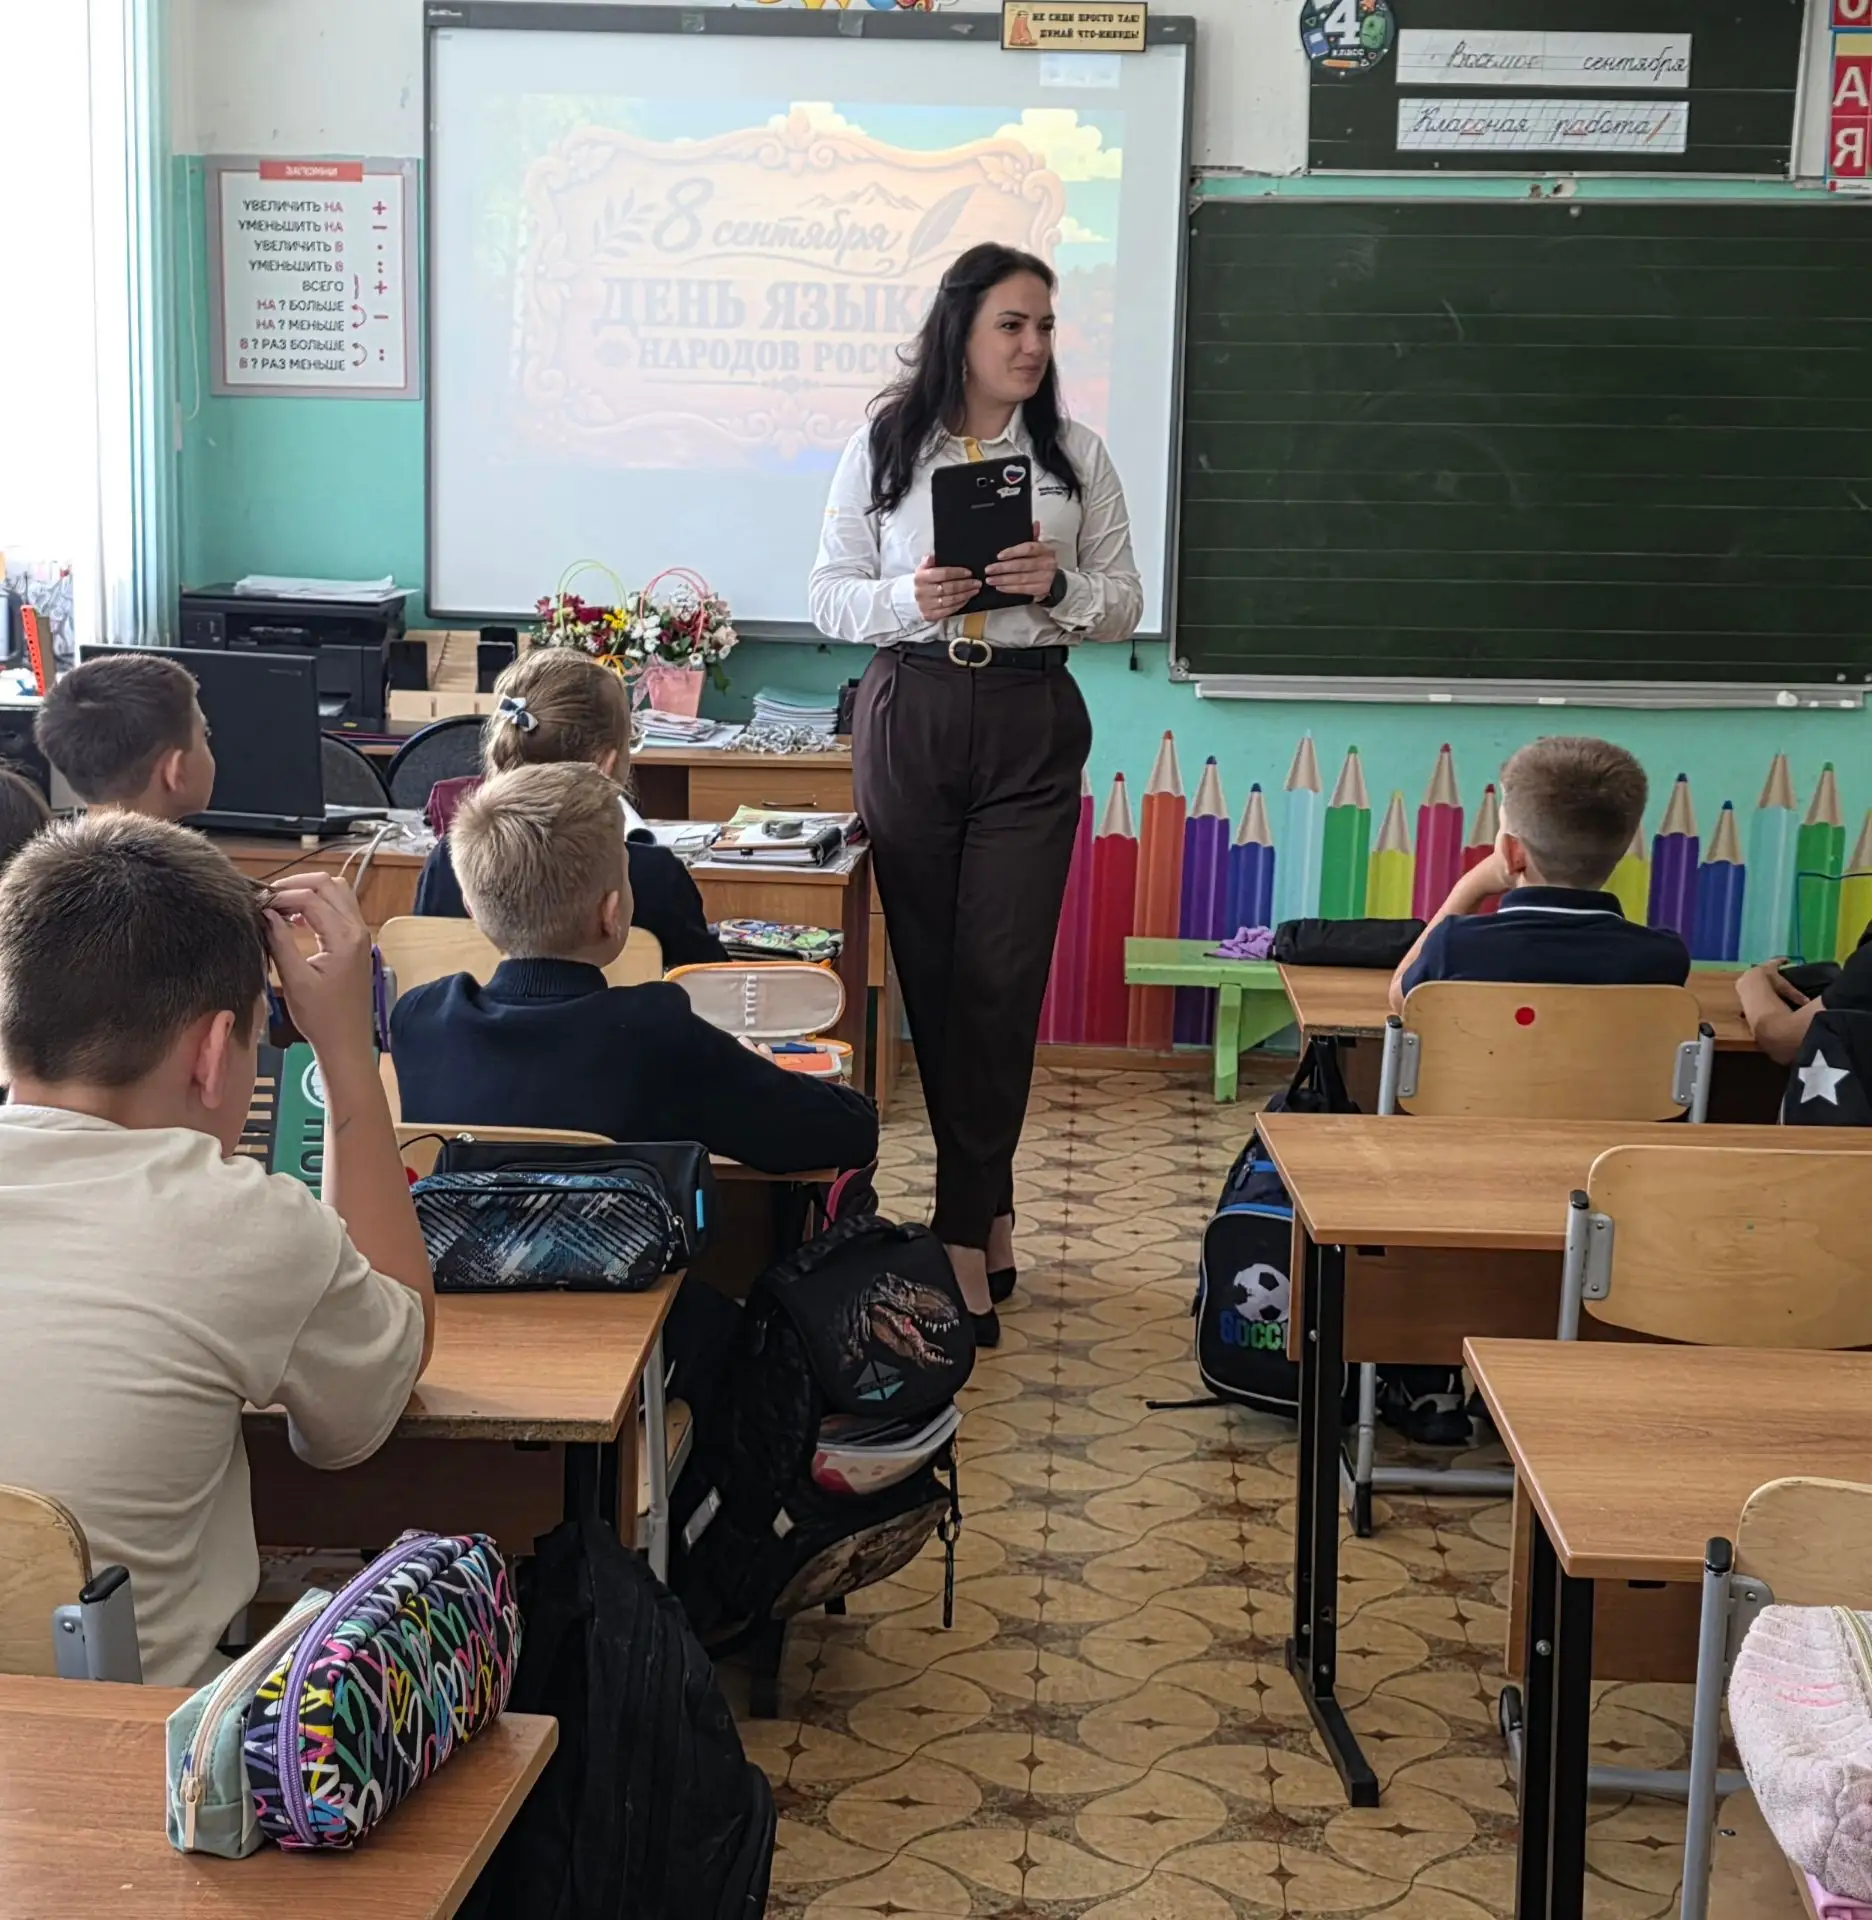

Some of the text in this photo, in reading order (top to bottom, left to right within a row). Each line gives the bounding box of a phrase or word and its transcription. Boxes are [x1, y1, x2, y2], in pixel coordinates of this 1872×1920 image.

[1583, 46, 1688, 81] сентября
[1413, 105, 1529, 133] Классная
[242, 200, 321, 212] УВЕЛИЧИТЬ
[324, 201, 344, 213] НА
[238, 220, 344, 232] УМЕНЬШИТЬ НА
[651, 176, 903, 266] 8 сентября
[254, 240, 344, 252] УВЕЛИЧИТЬ В
[248, 260, 344, 272] УМЕНЬШИТЬ В
[302, 280, 344, 292] ВСЕГО
[257, 300, 276, 311] НА
[289, 300, 345, 312] БОЛЬШЕ
[591, 276, 747, 338] ДЕНЬ
[256, 319, 276, 331] НА
[289, 320, 345, 332] МЕНЬШЕ
[240, 339, 249, 350] В
[261, 339, 287, 350] РАЗ
[290, 340, 345, 351] БОЛЬШЕ
[637, 337, 898, 378] НАРОДОВ РОСС
[239, 358, 248, 369] В
[261, 358, 287, 370] РАЗ
[289, 359, 346, 371] МЕНЬШЕ
